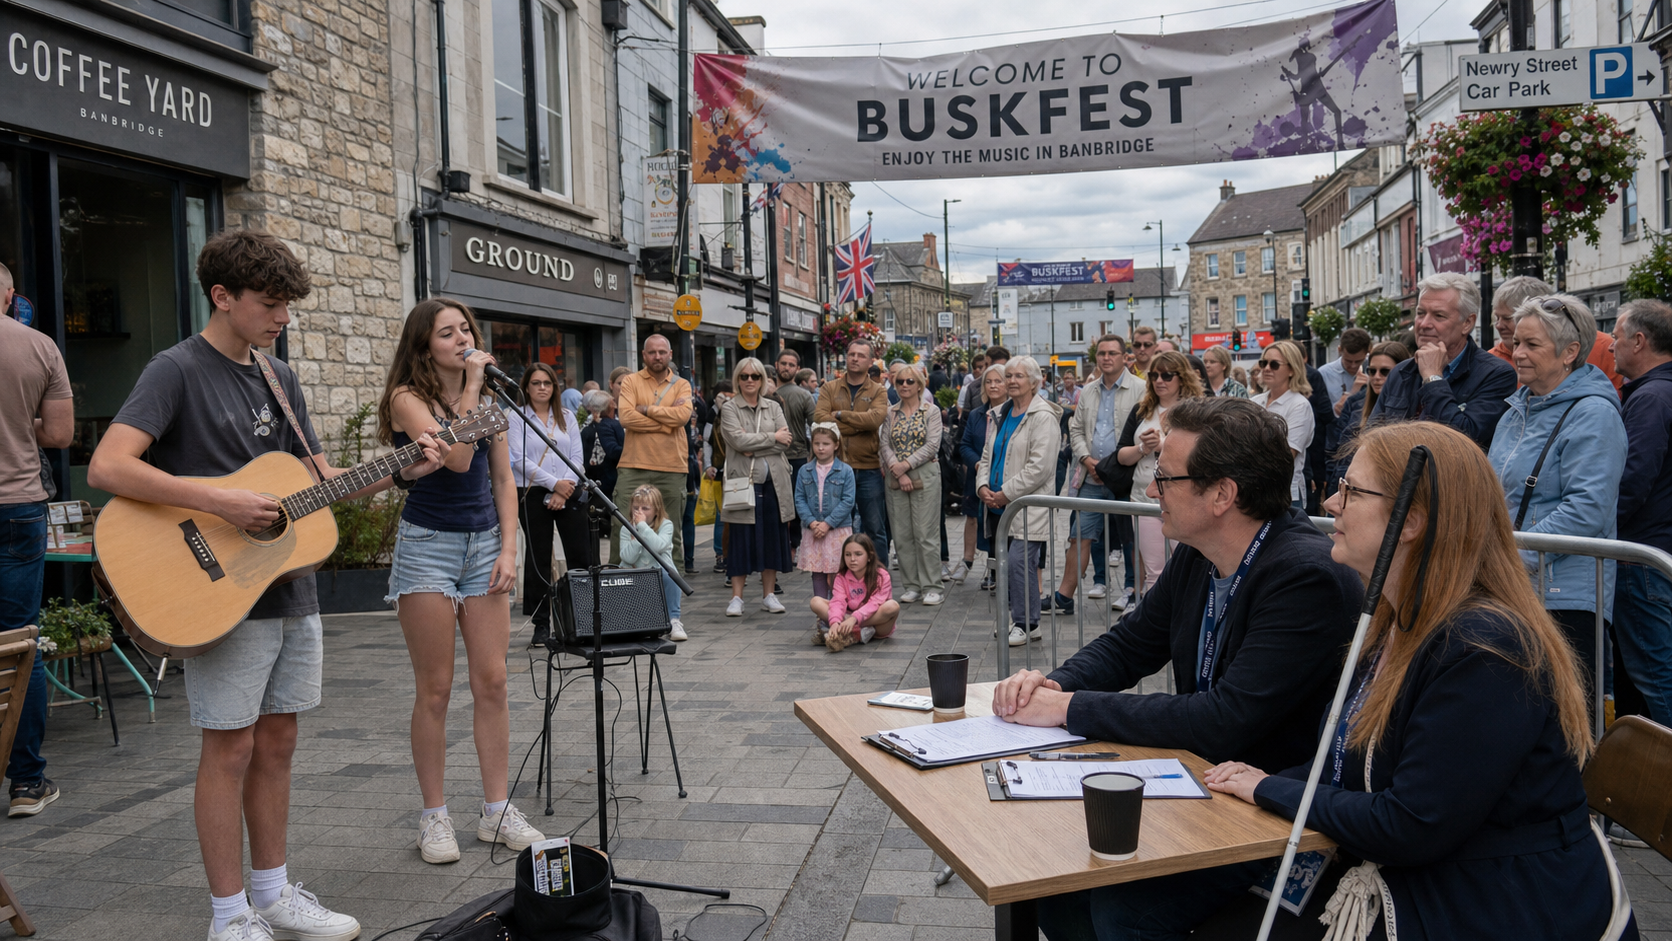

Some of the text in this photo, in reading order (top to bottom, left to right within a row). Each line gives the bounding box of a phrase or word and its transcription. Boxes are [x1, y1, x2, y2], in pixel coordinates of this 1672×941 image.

[8, 32, 214, 128] COFFEE YARD
[908, 52, 1123, 90] WELCOME TO
[1466, 55, 1578, 78] Newry Street
[1466, 79, 1551, 100] Car Park
[80, 107, 165, 138] BANBRIDGE
[856, 76, 1193, 143] BUSKFEST
[882, 137, 1155, 166] ENJOY THE MUSIC IN BANBRIDGE
[465, 236, 575, 282] GROUND
[1031, 266, 1085, 277] BUSKFEST
